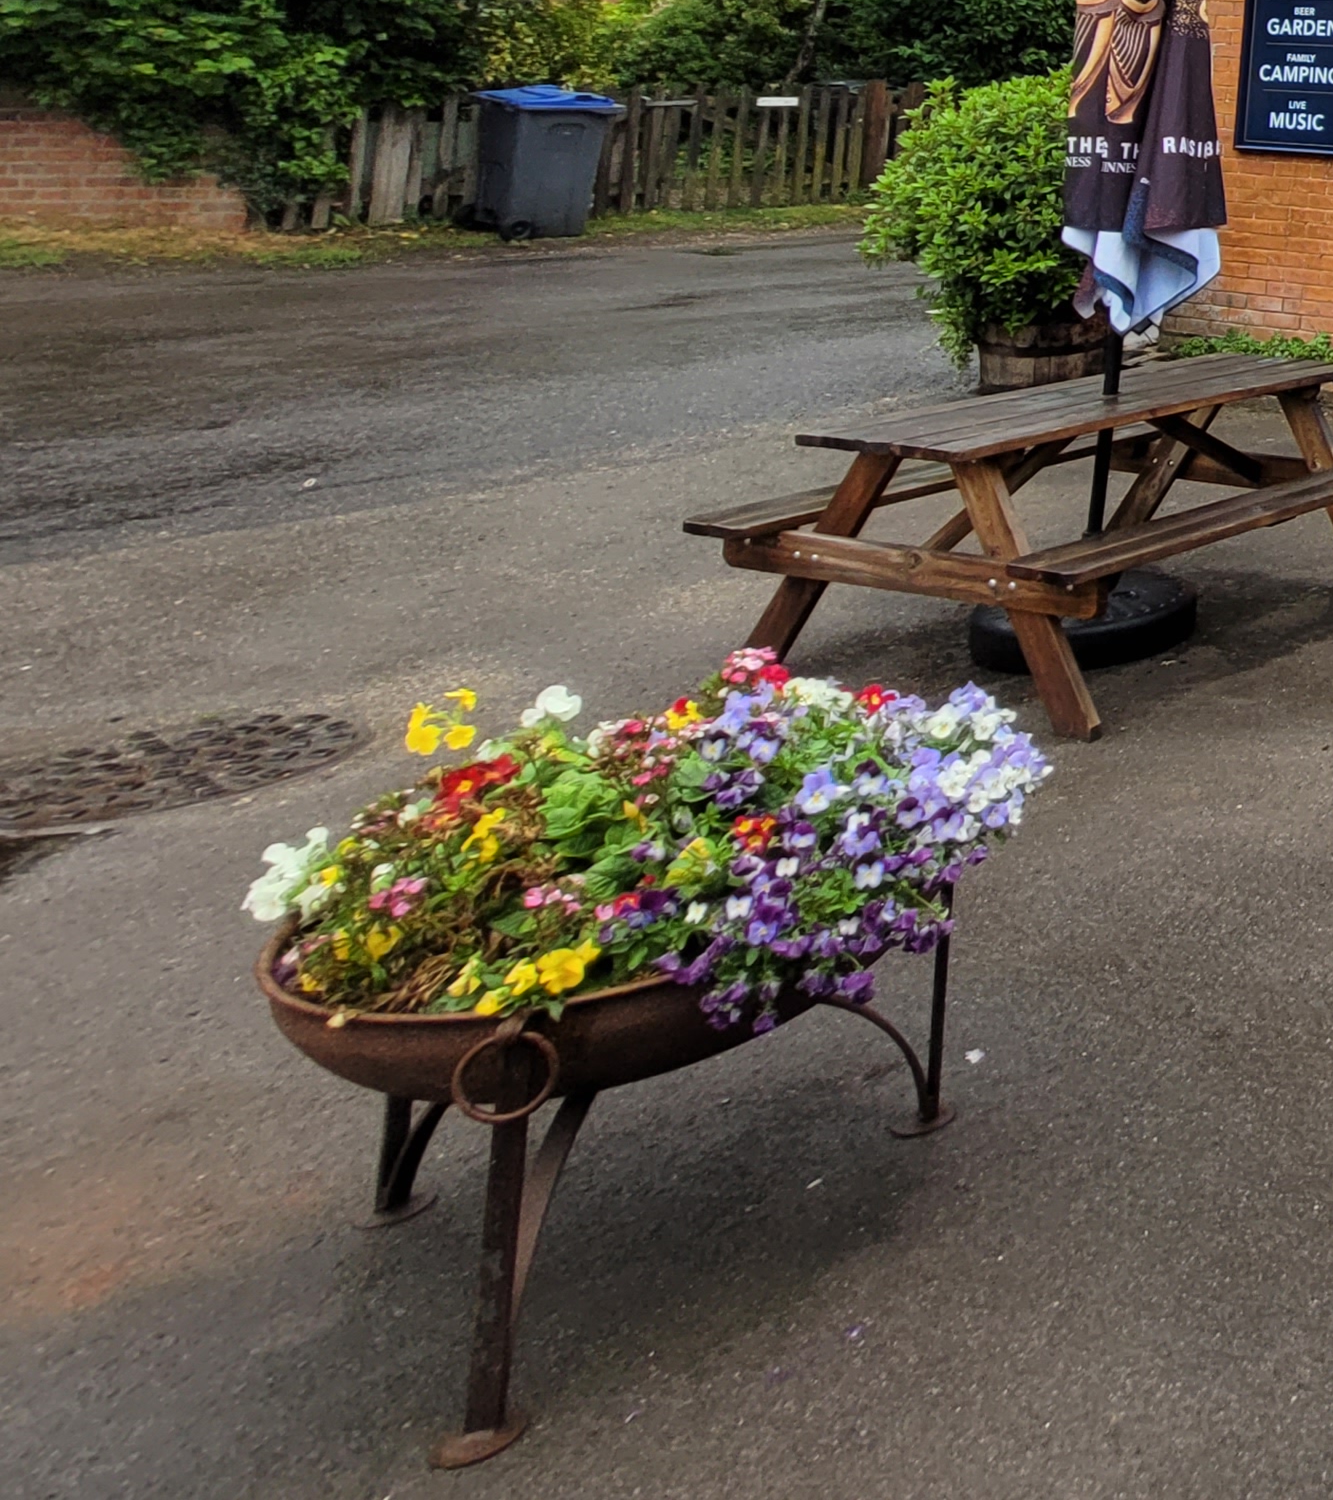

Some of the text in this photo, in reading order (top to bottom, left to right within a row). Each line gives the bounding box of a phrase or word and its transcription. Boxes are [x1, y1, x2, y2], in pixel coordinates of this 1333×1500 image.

[1294, 6, 1316, 16] BEER
[1286, 53, 1317, 63] FAMILY
[1288, 100, 1307, 110] LIVE
[1269, 111, 1326, 132] MUSIC
